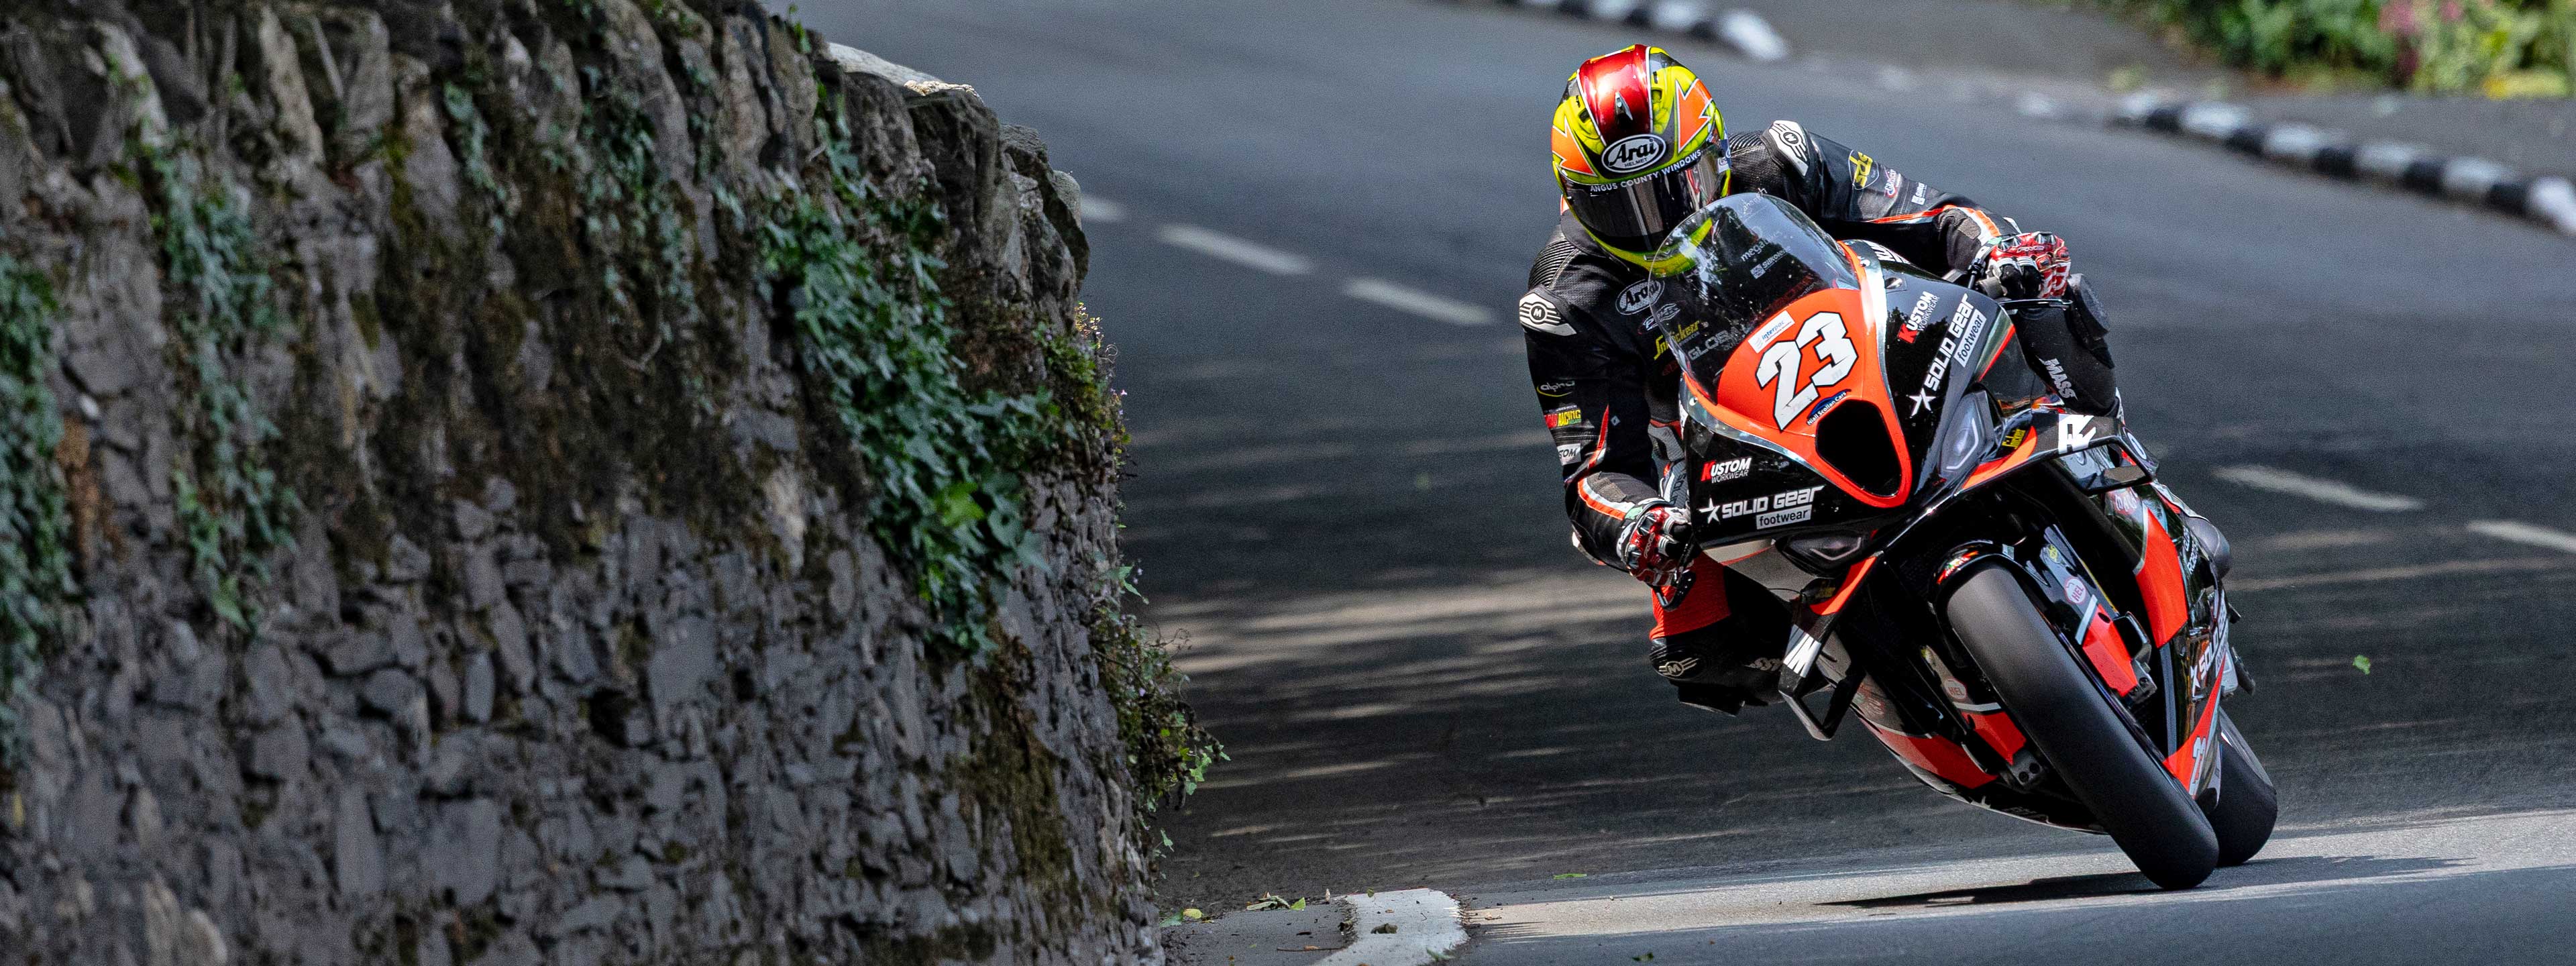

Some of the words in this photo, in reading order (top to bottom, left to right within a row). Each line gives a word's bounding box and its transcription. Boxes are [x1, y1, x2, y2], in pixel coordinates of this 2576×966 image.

[1608, 138, 1658, 166] Arai
[1624, 158, 1648, 167] HELMET
[1590, 183, 1618, 193] ANGUS
[1621, 172, 1659, 188] COUNTY
[1661, 150, 1702, 175] WINDOWS
[1896, 291, 1934, 344] KUSTOM
[1917, 295, 1941, 331] WORKWEAR
[1957, 314, 1984, 362] footwear
[1756, 311, 1858, 431] 23
[1923, 337, 1956, 391] SOLID
[2041, 356, 2078, 400] MASS
[1701, 458, 1752, 482] KUSTOM
[1711, 469, 1750, 484] WORKWEAR
[1721, 496, 1769, 519] SOLID
[1759, 510, 1809, 527] footwear
